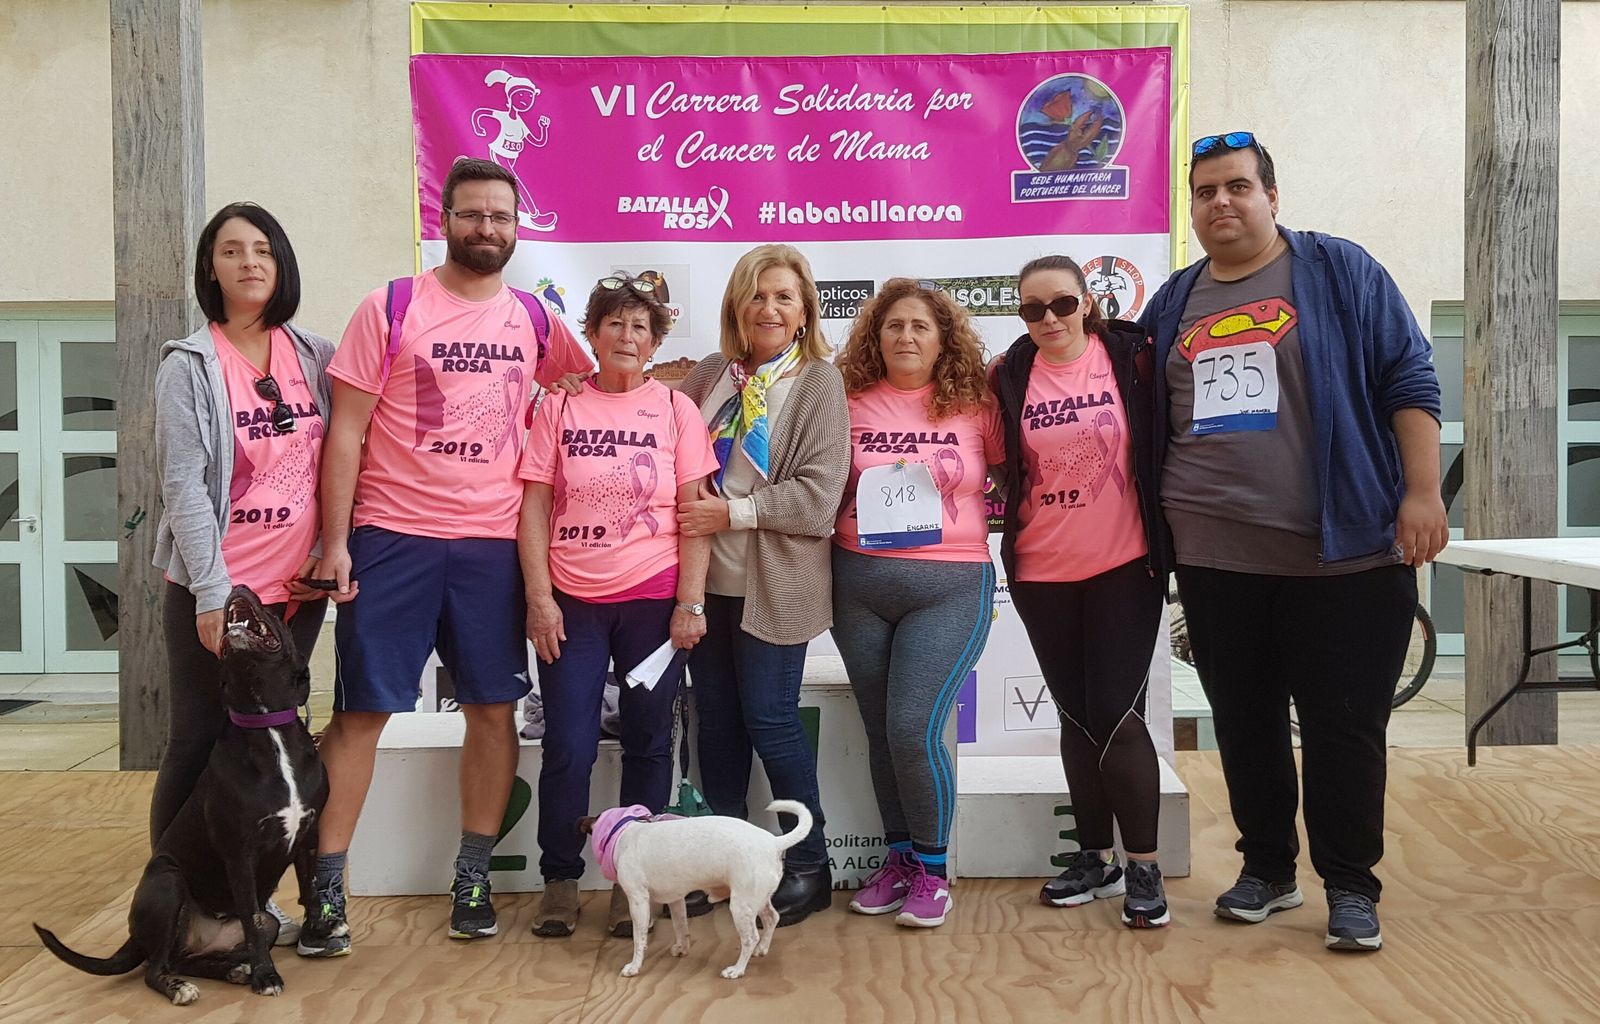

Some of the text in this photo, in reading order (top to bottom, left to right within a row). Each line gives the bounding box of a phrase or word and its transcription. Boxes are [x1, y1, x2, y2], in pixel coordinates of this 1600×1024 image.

[590, 81, 974, 119] VI Carrera Solidaria por
[637, 129, 932, 169] el Cancer de Mama
[1030, 172, 1112, 185] SEDE HUMANITARIA
[1020, 184, 1121, 197] PORTUENSE DEL CANCER
[617, 196, 709, 213] BATALLA
[758, 199, 963, 224] #labatallarosa
[1120, 261, 1143, 286] SHOP
[431, 342, 525, 362] BATALLA
[442, 359, 492, 373] ROSA
[1198, 351, 1265, 401] 735
[236, 402, 321, 428] BALLA
[1023, 391, 1115, 420] BATALLA
[1030, 411, 1079, 431] ROSA
[428, 440, 483, 457] 2019
[561, 429, 657, 449] BATALLA
[859, 432, 959, 446] BATALLA
[567, 445, 617, 458] ROSA
[862, 444, 919, 454] ROSA
[880, 484, 917, 507] 818
[1040, 489, 1080, 507] 2019
[231, 507, 291, 523] 2019
[559, 525, 606, 541] 2019
